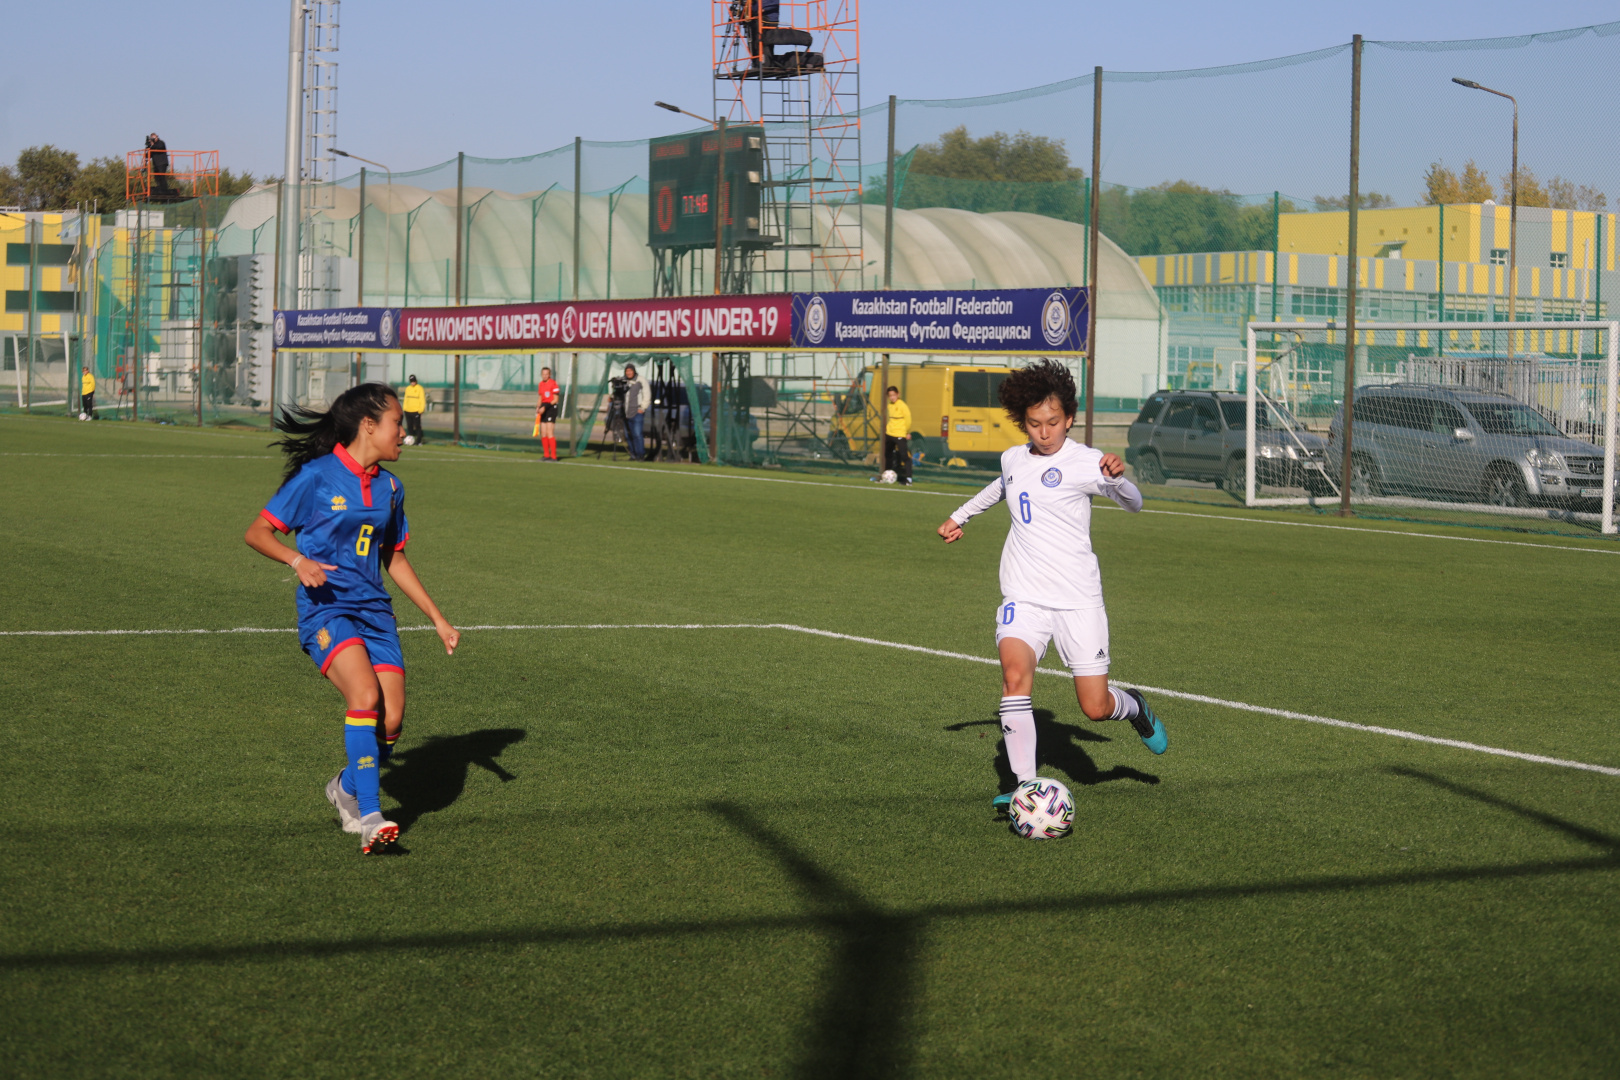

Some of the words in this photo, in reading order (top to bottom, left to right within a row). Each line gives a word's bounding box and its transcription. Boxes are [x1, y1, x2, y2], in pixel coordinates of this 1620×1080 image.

[657, 186, 673, 232] 0
[852, 297, 908, 315] Kazakhstan
[909, 297, 954, 315] Football
[955, 296, 1013, 315] Federation
[407, 317, 435, 341] UEFA
[435, 315, 493, 341] WOMEN'S
[495, 312, 560, 340] UNDER-19
[578, 312, 616, 338] UEFA
[616, 308, 691, 338] WOMEN'S
[694, 306, 779, 337] UNDER-19
[835, 321, 908, 342] Қазақстанның
[909, 321, 950, 343] Футбол
[952, 321, 1031, 343] Федерациясы
[1019, 491, 1032, 524] 6
[355, 524, 374, 556] 6
[1002, 601, 1016, 625] 6
